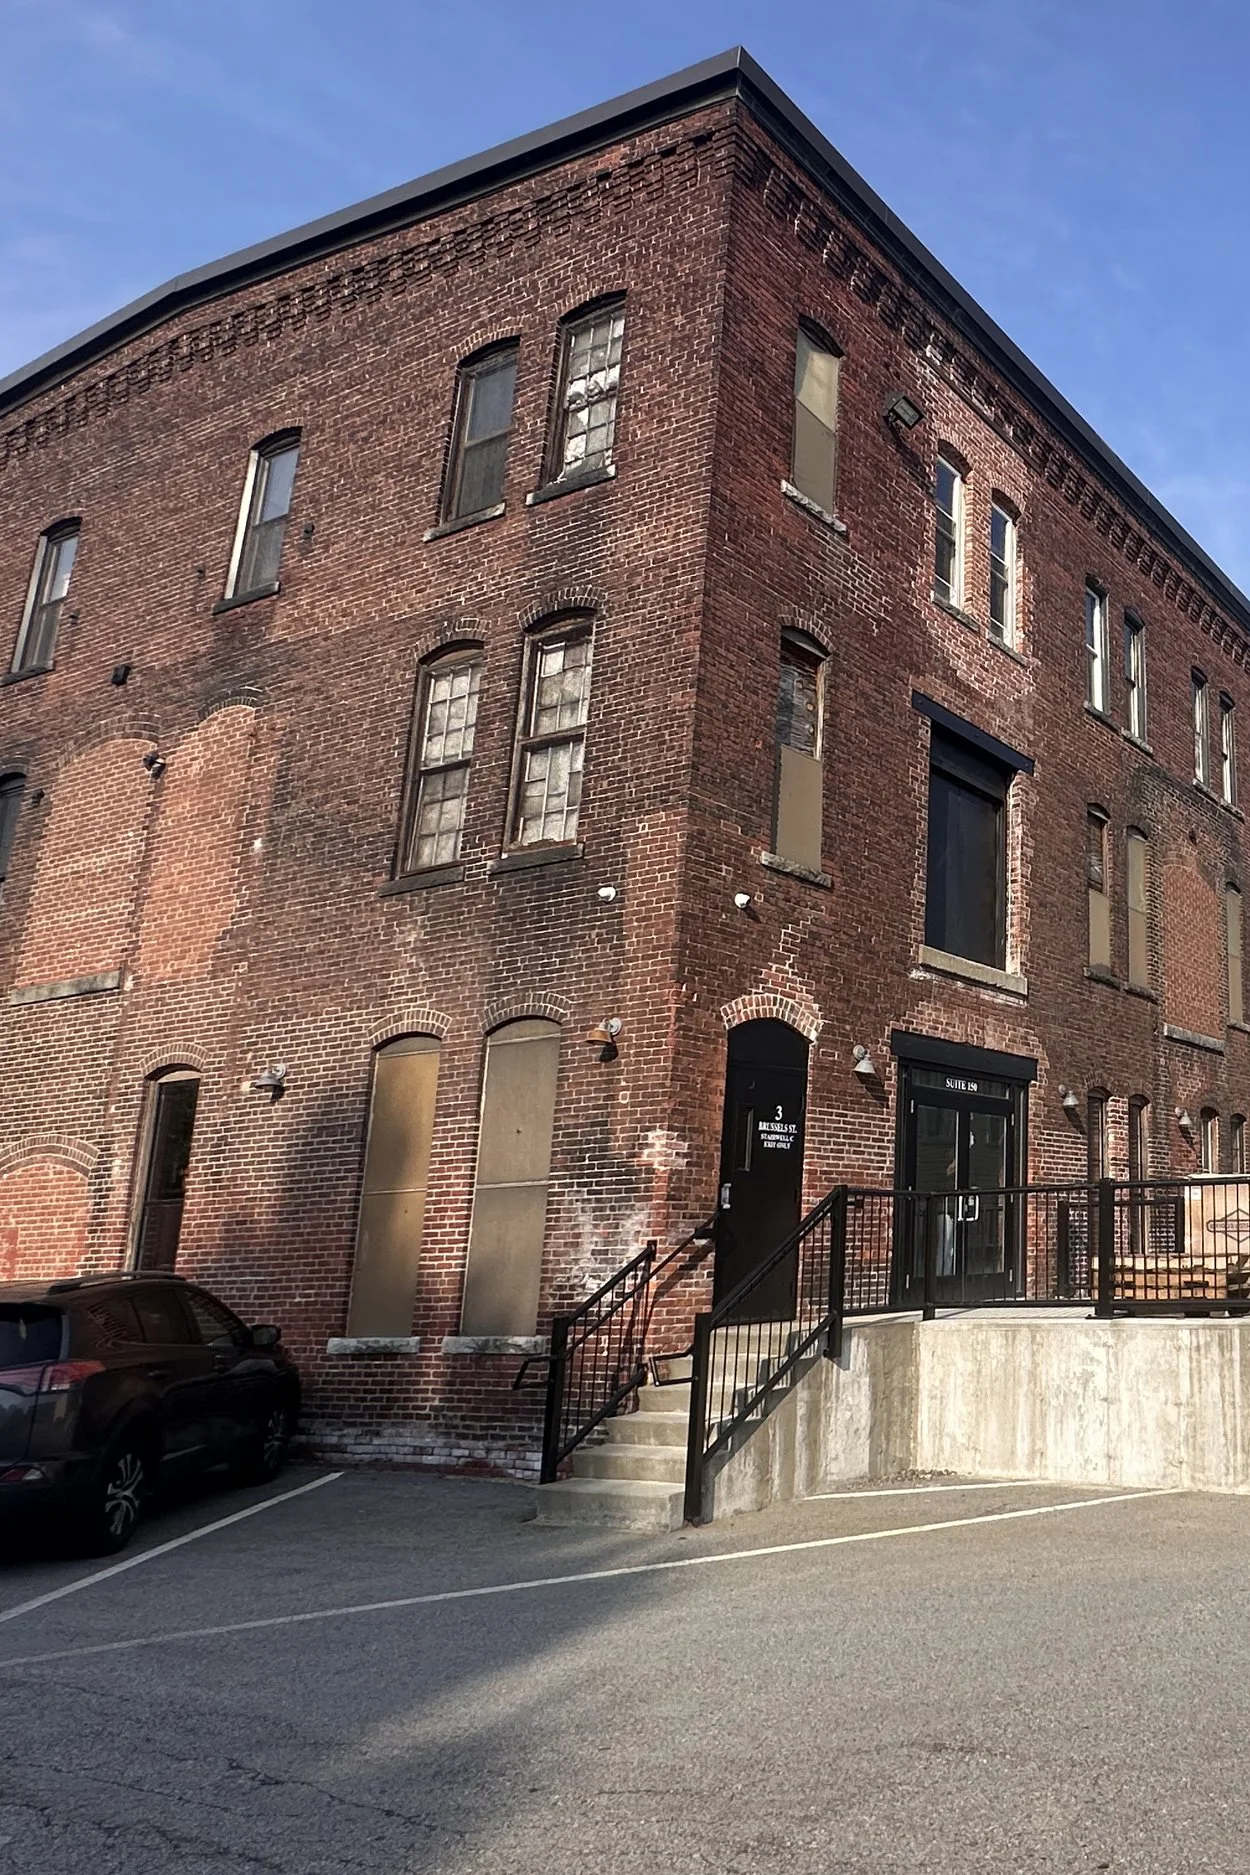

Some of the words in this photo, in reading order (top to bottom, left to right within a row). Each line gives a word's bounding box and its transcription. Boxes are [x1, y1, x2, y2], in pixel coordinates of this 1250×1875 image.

[946, 1077, 967, 1090] SUITE
[967, 1081, 978, 1092] 150
[774, 1105, 783, 1120] 3
[758, 1121, 788, 1133] BRUSSELS
